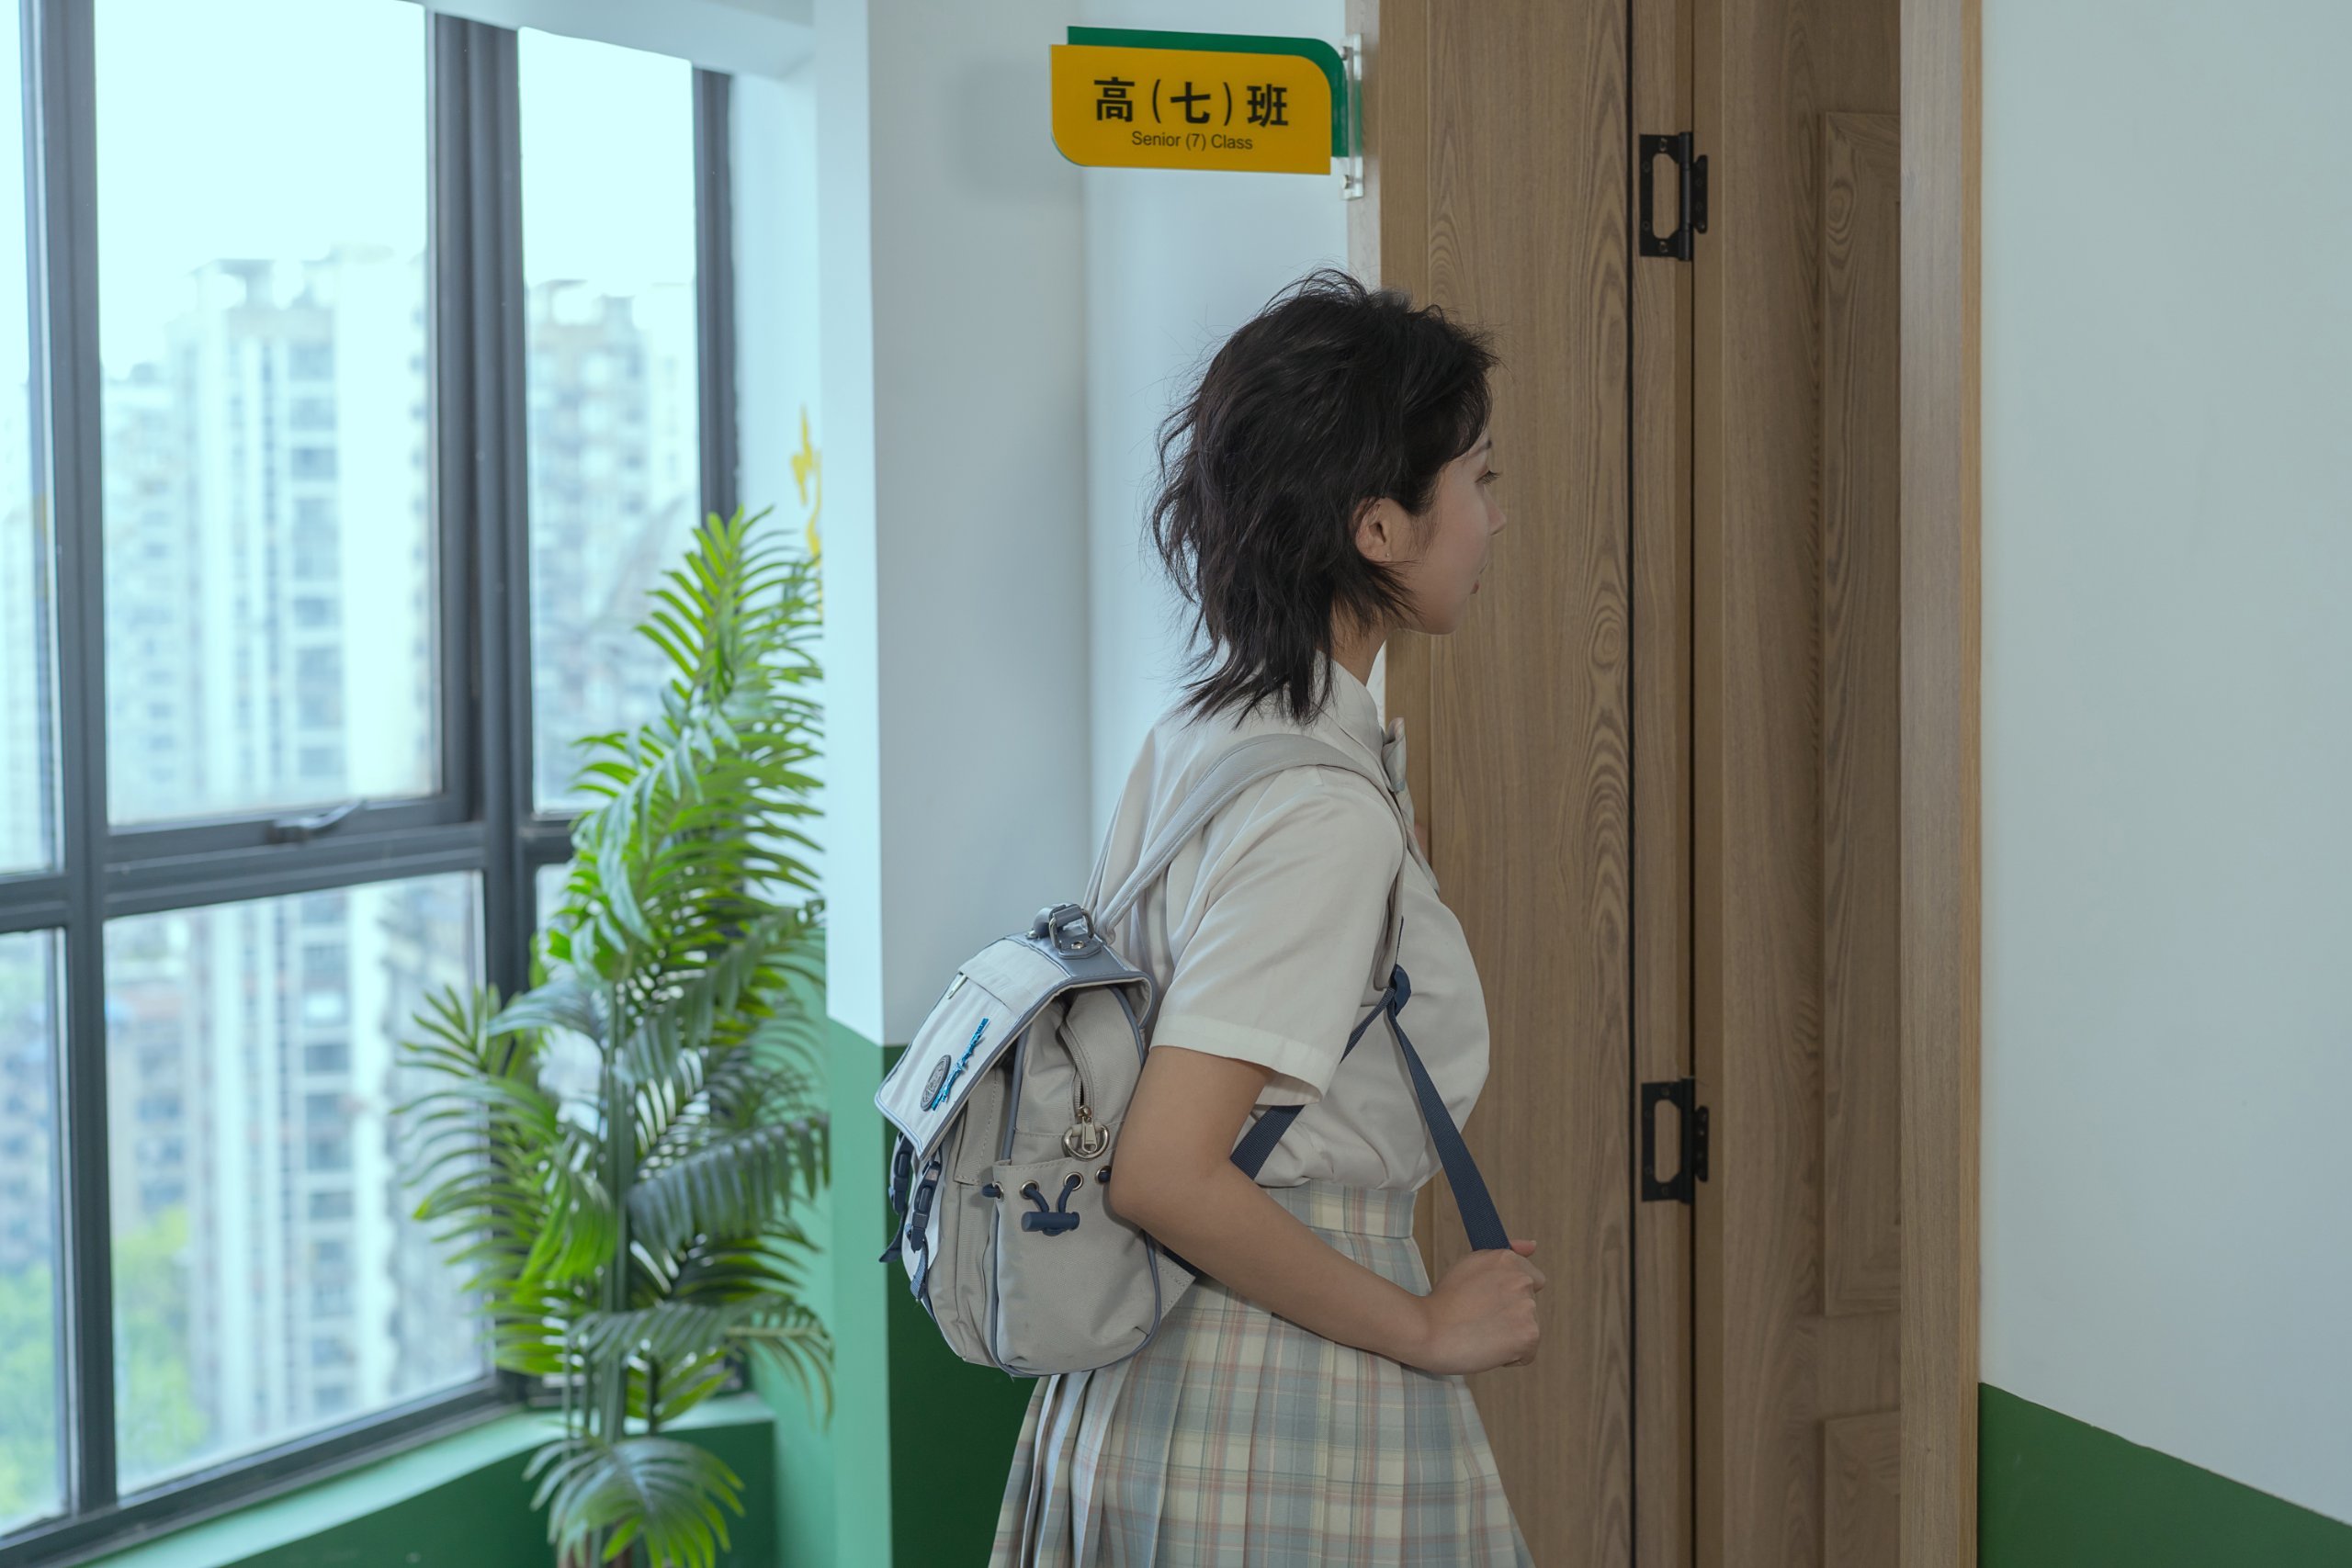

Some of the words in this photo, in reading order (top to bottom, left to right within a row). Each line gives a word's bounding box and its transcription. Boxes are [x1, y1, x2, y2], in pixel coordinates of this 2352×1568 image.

[1132, 130, 1182, 147] Senior
[1185, 133, 1206, 152] (7)
[1211, 134, 1253, 150] Class
